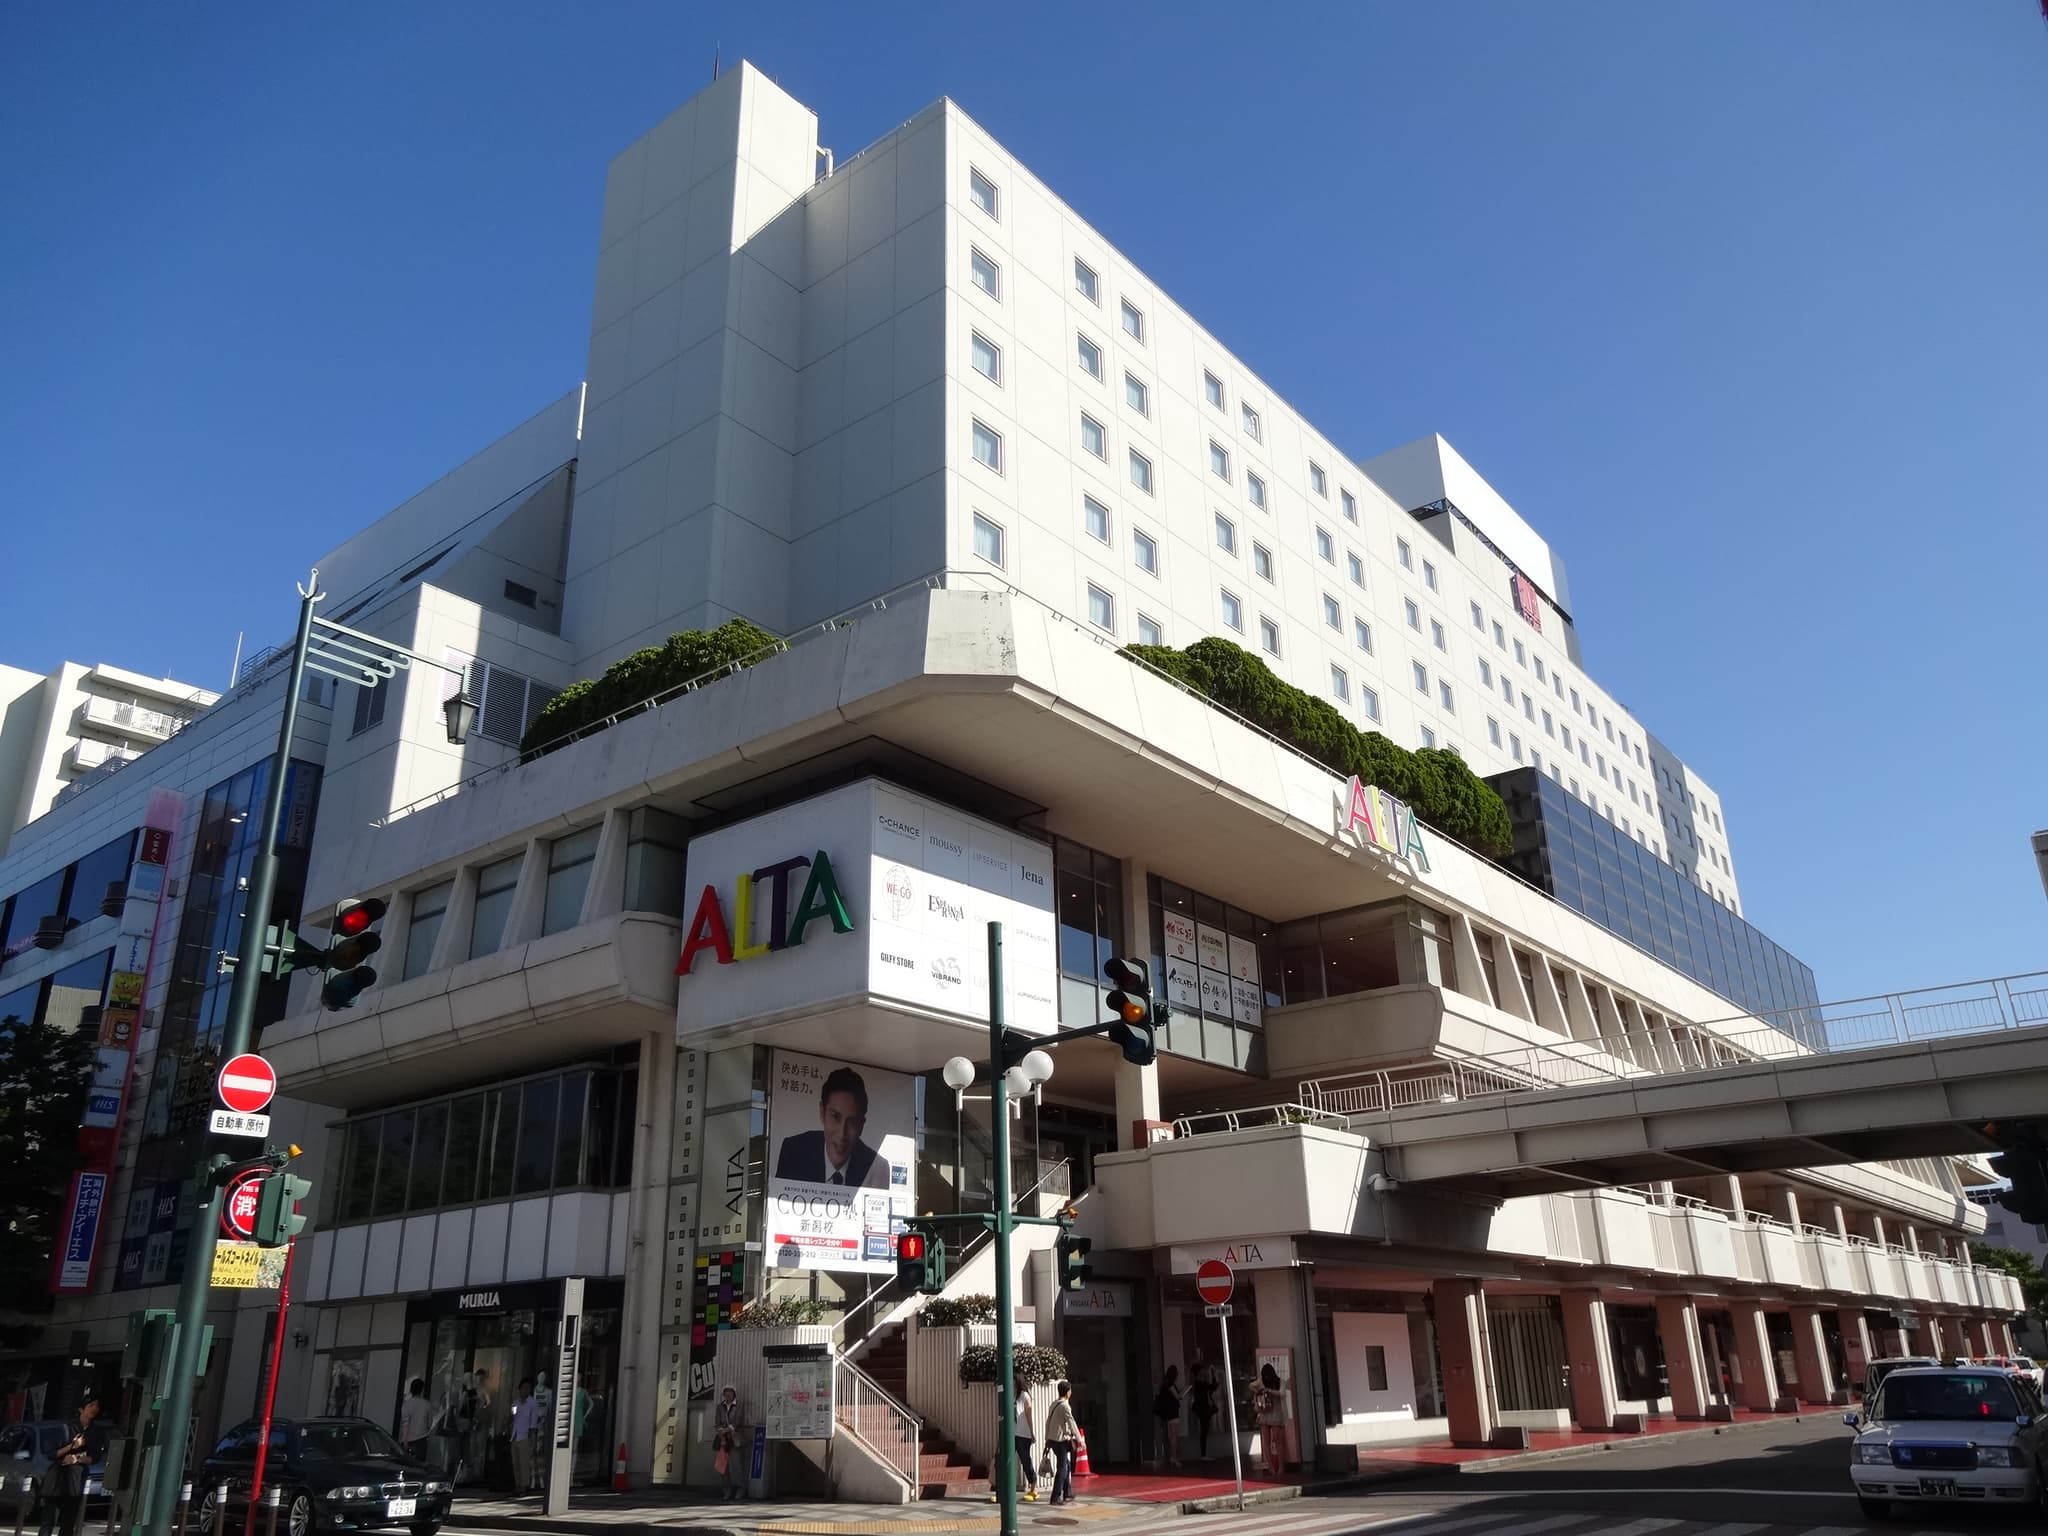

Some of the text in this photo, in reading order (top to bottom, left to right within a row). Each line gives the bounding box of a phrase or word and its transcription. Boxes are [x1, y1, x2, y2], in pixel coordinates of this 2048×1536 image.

[1343, 774, 1432, 874] ALTA
[929, 835, 963, 857] moussy
[1020, 866, 1045, 886] Jena
[674, 849, 855, 976] ALTA
[896, 956, 915, 970] STORE
[781, 1062, 824, 1080] 決め手は、
[781, 1079, 813, 1095] 対話力。
[216, 1116, 264, 1133] 自動車・原付
[725, 1146, 746, 1216] ALTA
[777, 1193, 859, 1220] COCO塾
[68, 1178, 93, 1259] エイチ・アイ・エス
[215, 1248, 259, 1266] ールズコートネイル
[459, 1292, 500, 1309] MURUA
[690, 1361, 716, 1394] Cu
